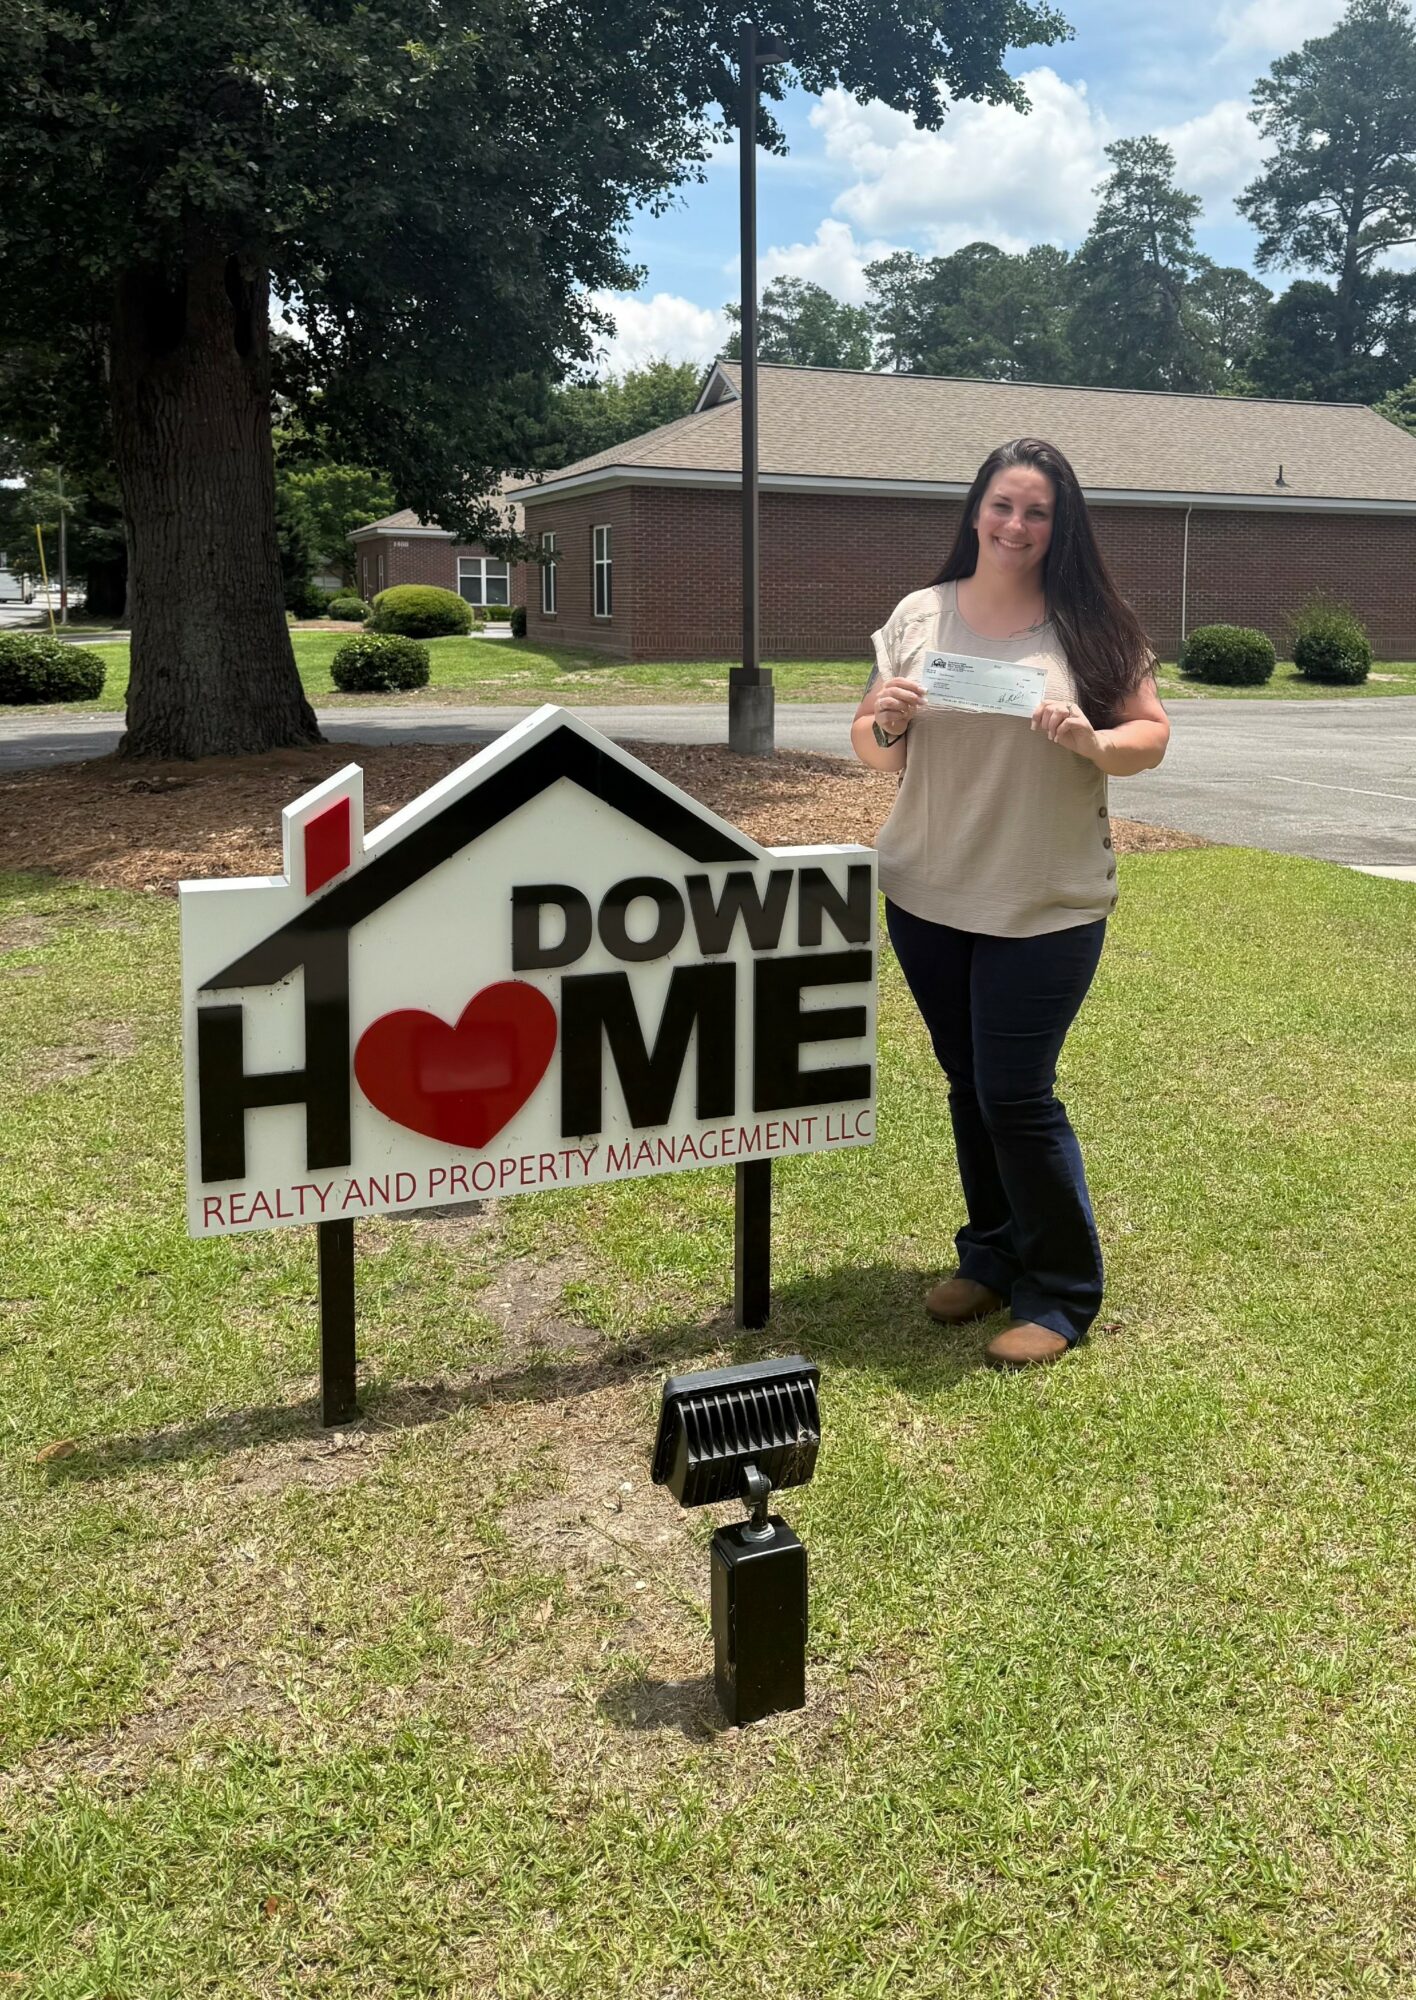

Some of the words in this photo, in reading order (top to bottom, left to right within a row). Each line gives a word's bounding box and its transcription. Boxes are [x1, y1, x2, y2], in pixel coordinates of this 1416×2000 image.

[511, 864, 872, 972] DOWN
[202, 1181, 334, 1228] REALTY
[341, 1171, 417, 1210] AND
[428, 1145, 599, 1198] PROPERTY
[605, 1116, 818, 1174] MANAGEMENT
[825, 1109, 872, 1142] LLC
